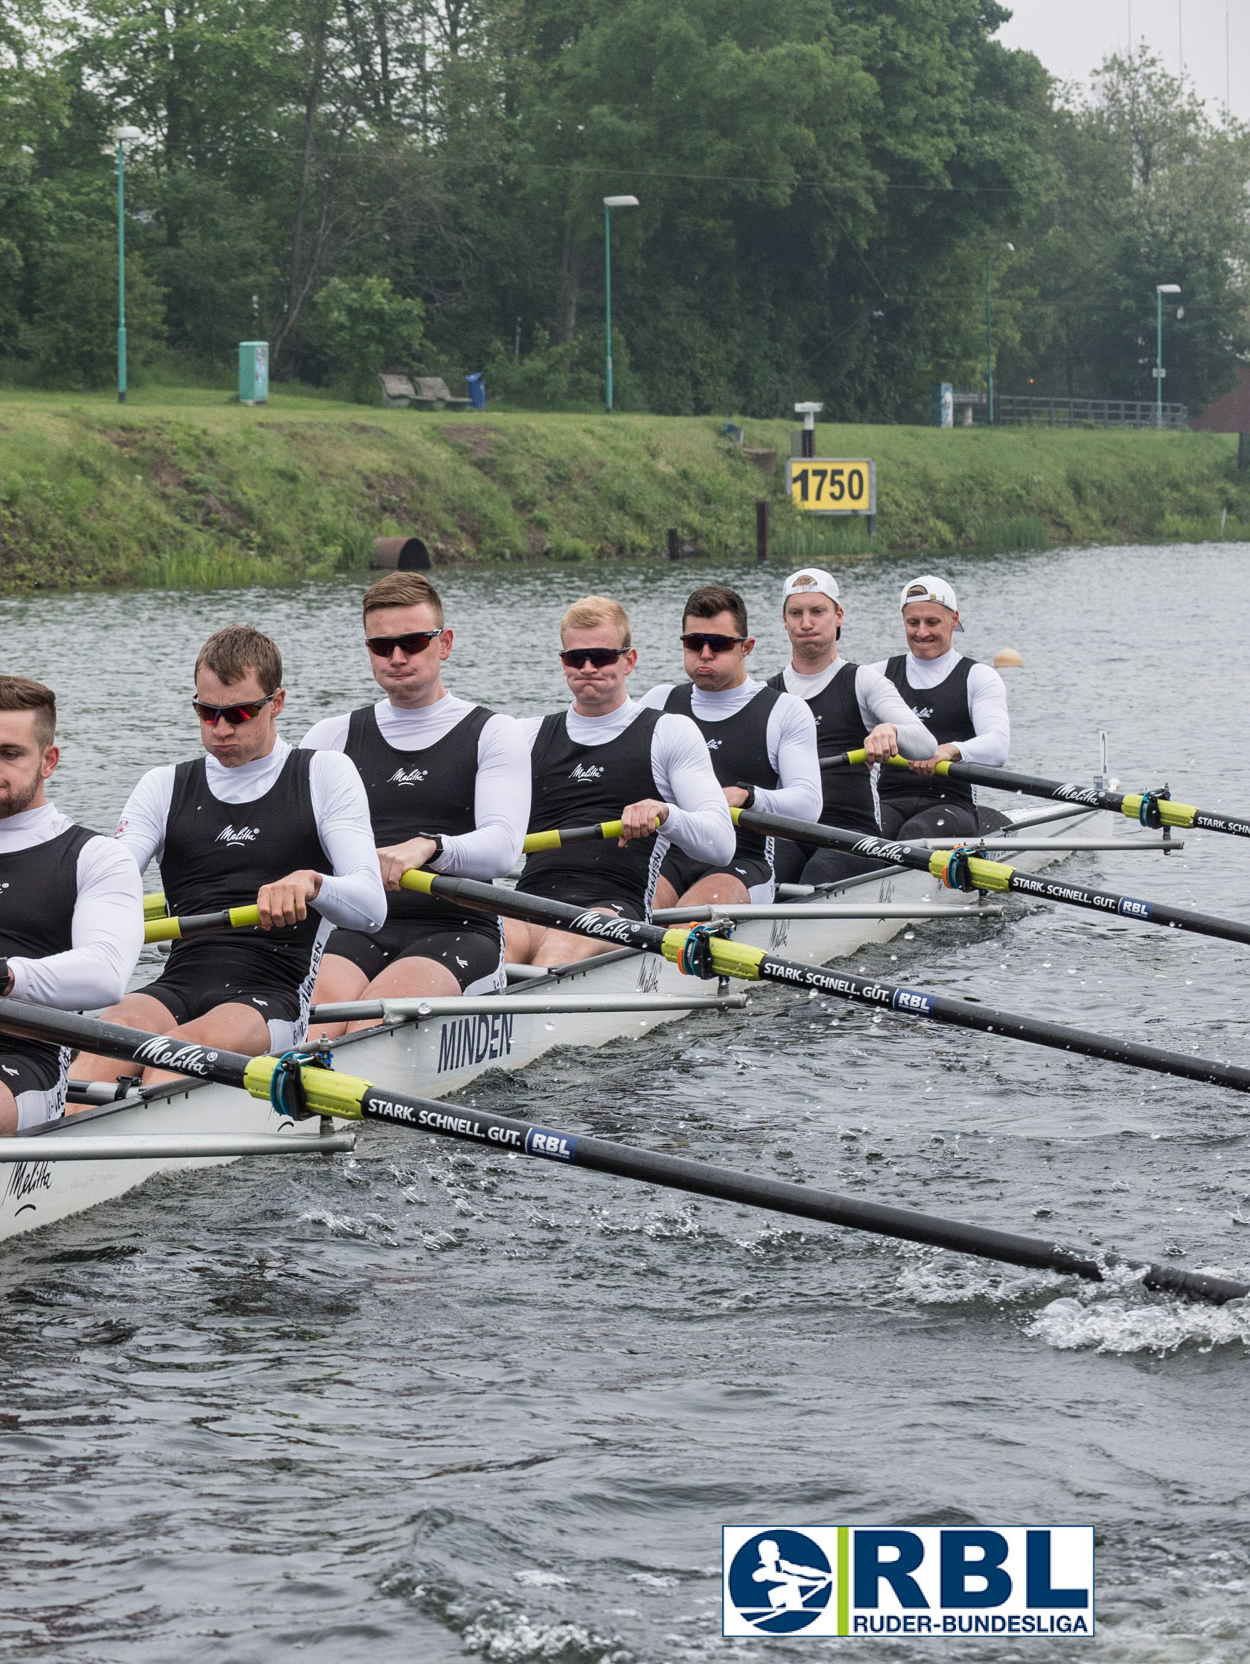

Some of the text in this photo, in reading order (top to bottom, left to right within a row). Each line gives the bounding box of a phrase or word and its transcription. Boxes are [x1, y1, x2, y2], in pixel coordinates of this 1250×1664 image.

[792, 469, 863, 501] 1750
[1197, 816, 1226, 829] STARK.
[1013, 877, 1045, 893] STARK.
[1047, 885, 1092, 904] SCHNELL.
[1093, 896, 1116, 909] GUT.
[1123, 900, 1148, 915] RBL
[764, 962, 803, 982] STARK.
[805, 972, 860, 995] SCHNELL.
[863, 986, 889, 1002] GUT.
[899, 993, 930, 1010] RBL
[438, 1014, 513, 1074] MINDEN
[368, 1098, 416, 1122] STARK.
[419, 1110, 485, 1138] SCHNELL.
[488, 1126, 521, 1146] GUT.
[532, 1132, 570, 1155] RBL
